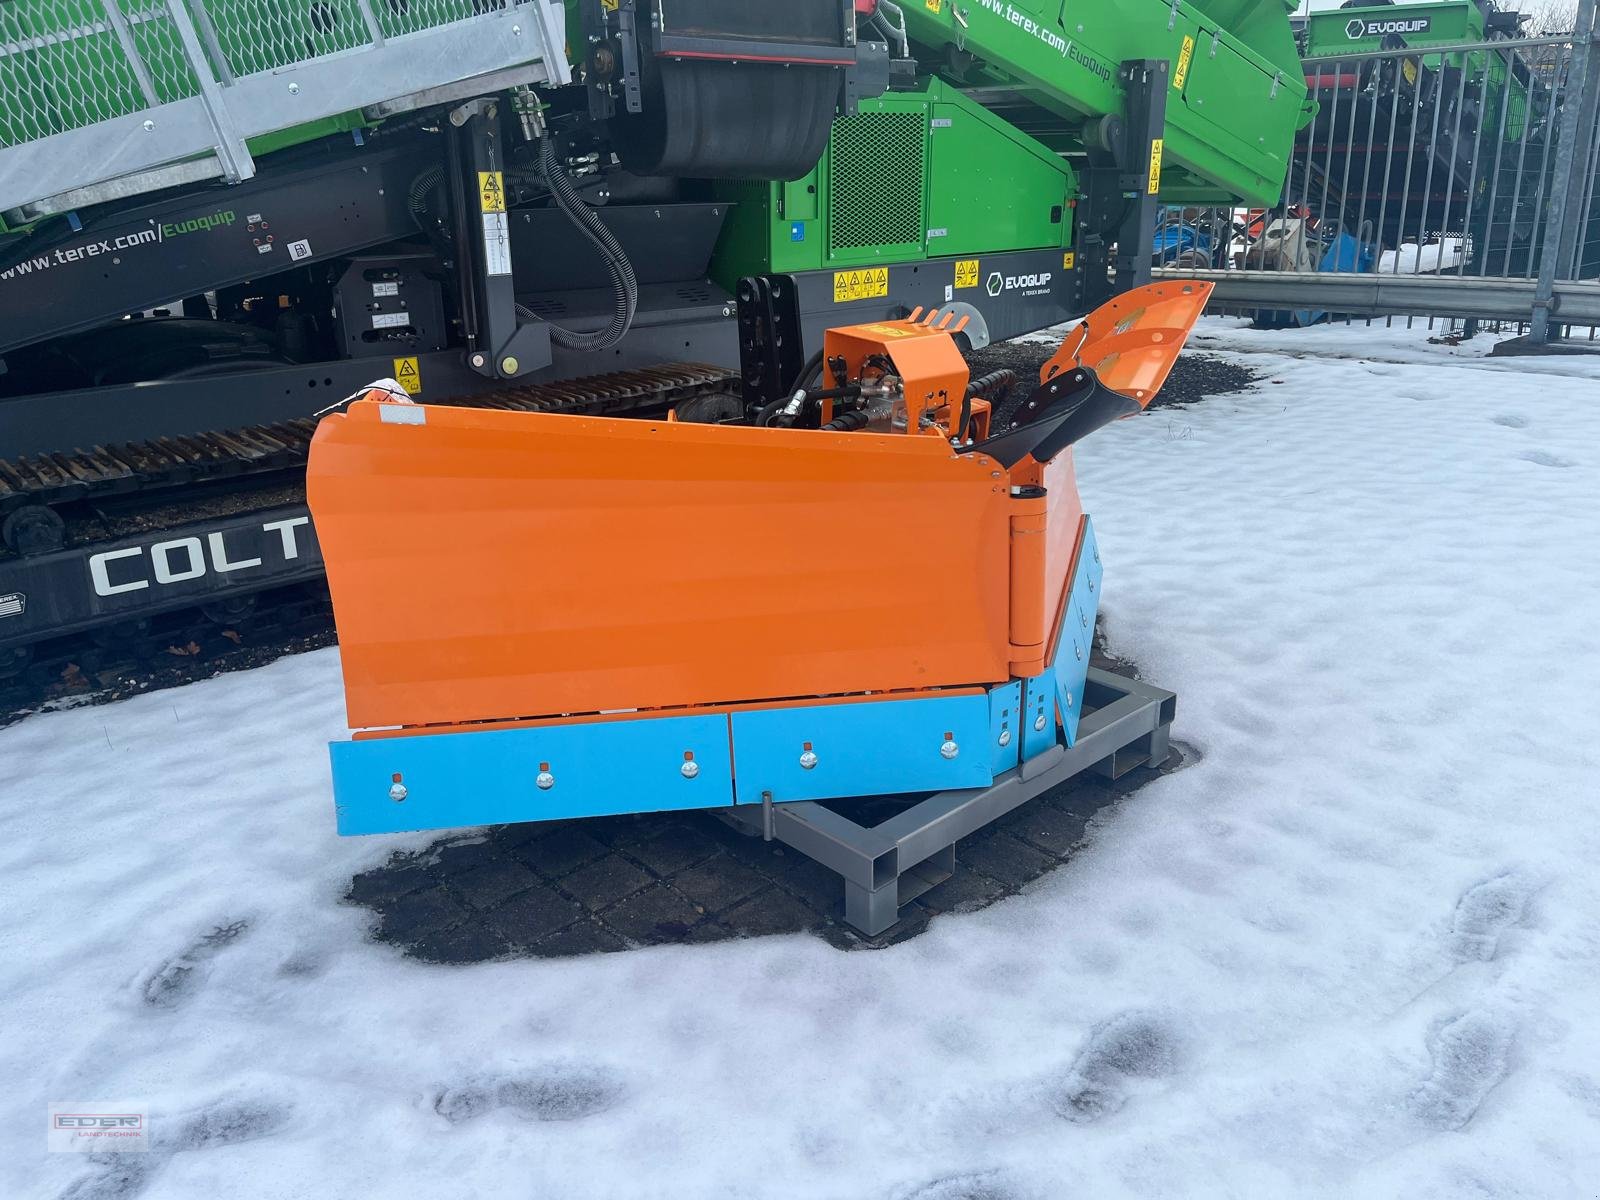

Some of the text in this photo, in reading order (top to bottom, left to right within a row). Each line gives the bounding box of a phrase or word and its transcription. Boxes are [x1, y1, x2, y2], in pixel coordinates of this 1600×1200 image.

[976, 0, 1110, 82] ww.terex.com/EvoQuip
[1367, 20, 1427, 34] EVOQUIP
[1005, 272, 1051, 289] EVOQUIP
[89, 516, 309, 597] COLT
